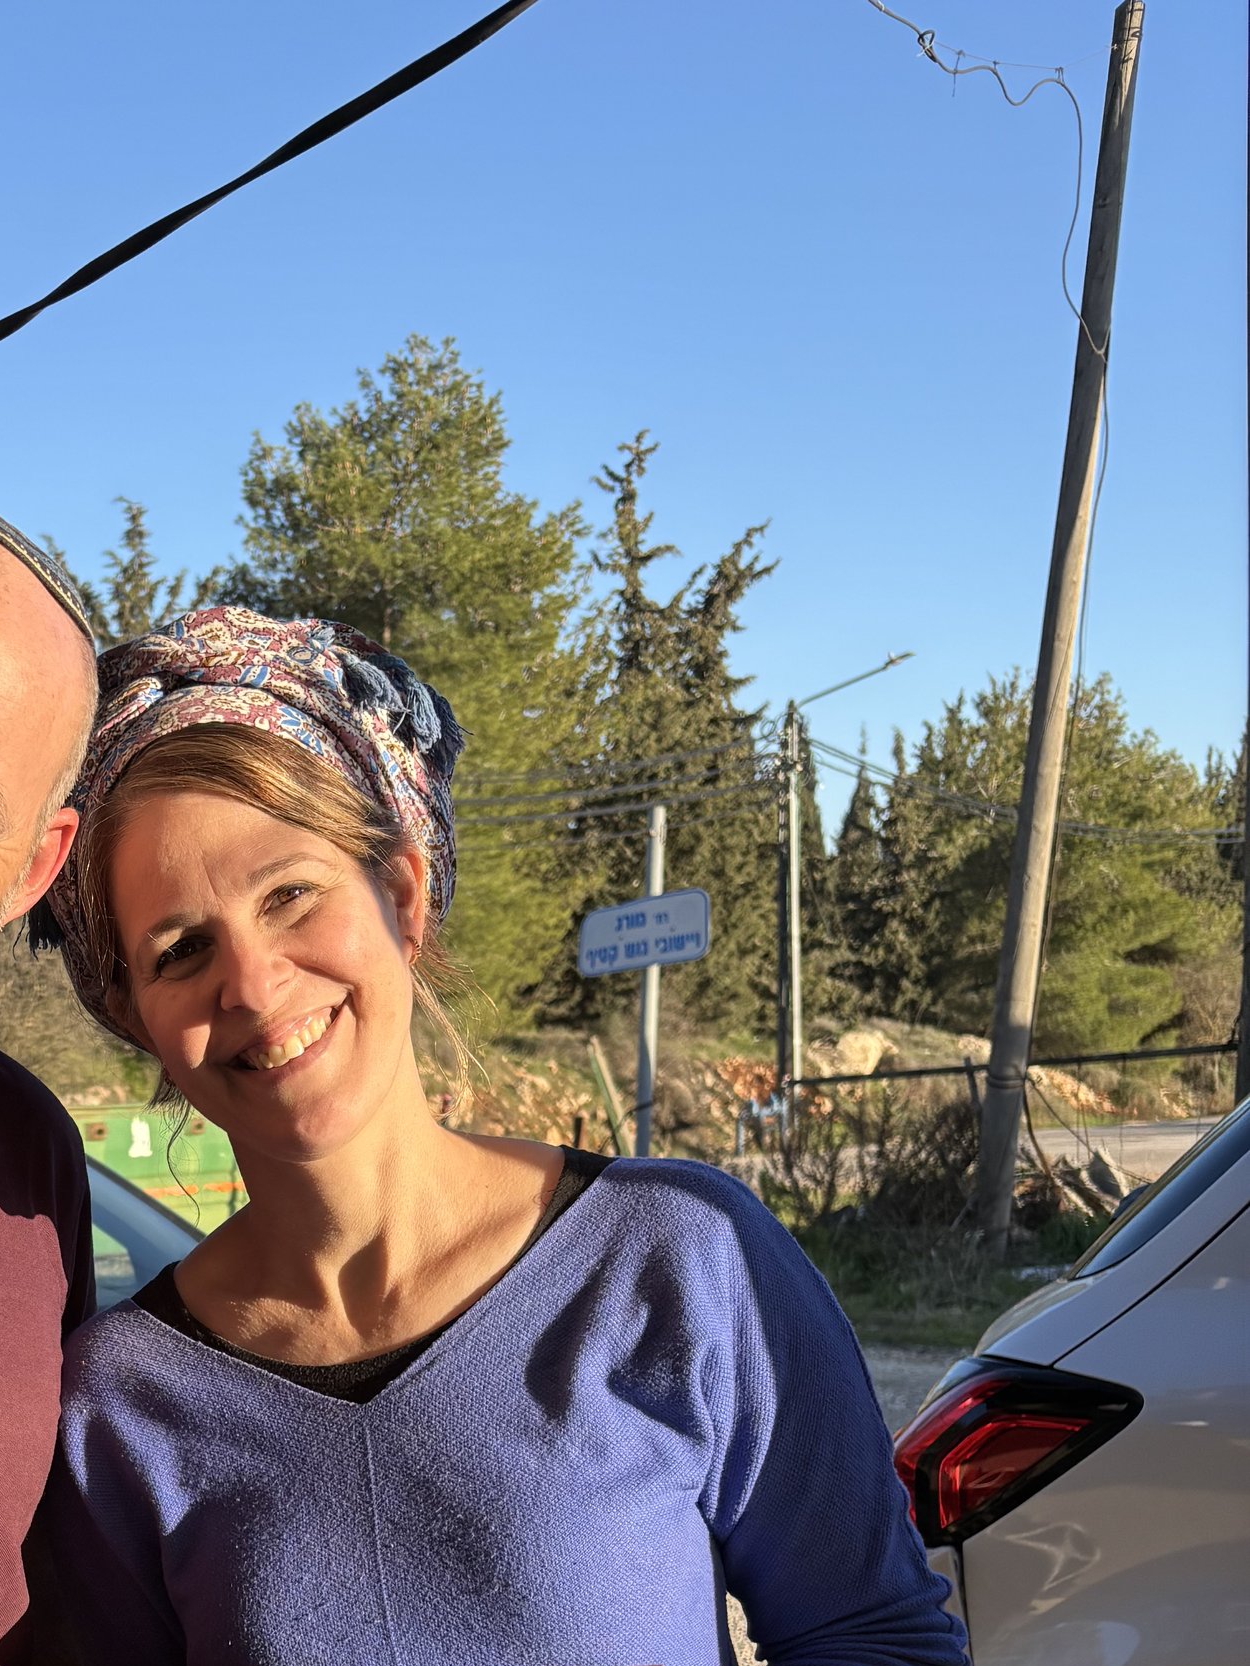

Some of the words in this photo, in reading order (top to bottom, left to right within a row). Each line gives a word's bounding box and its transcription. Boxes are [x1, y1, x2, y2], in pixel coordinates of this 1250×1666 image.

[615, 911, 646, 932] מורג
[586, 944, 618, 969] קטיף
[624, 938, 648, 958] גוש
